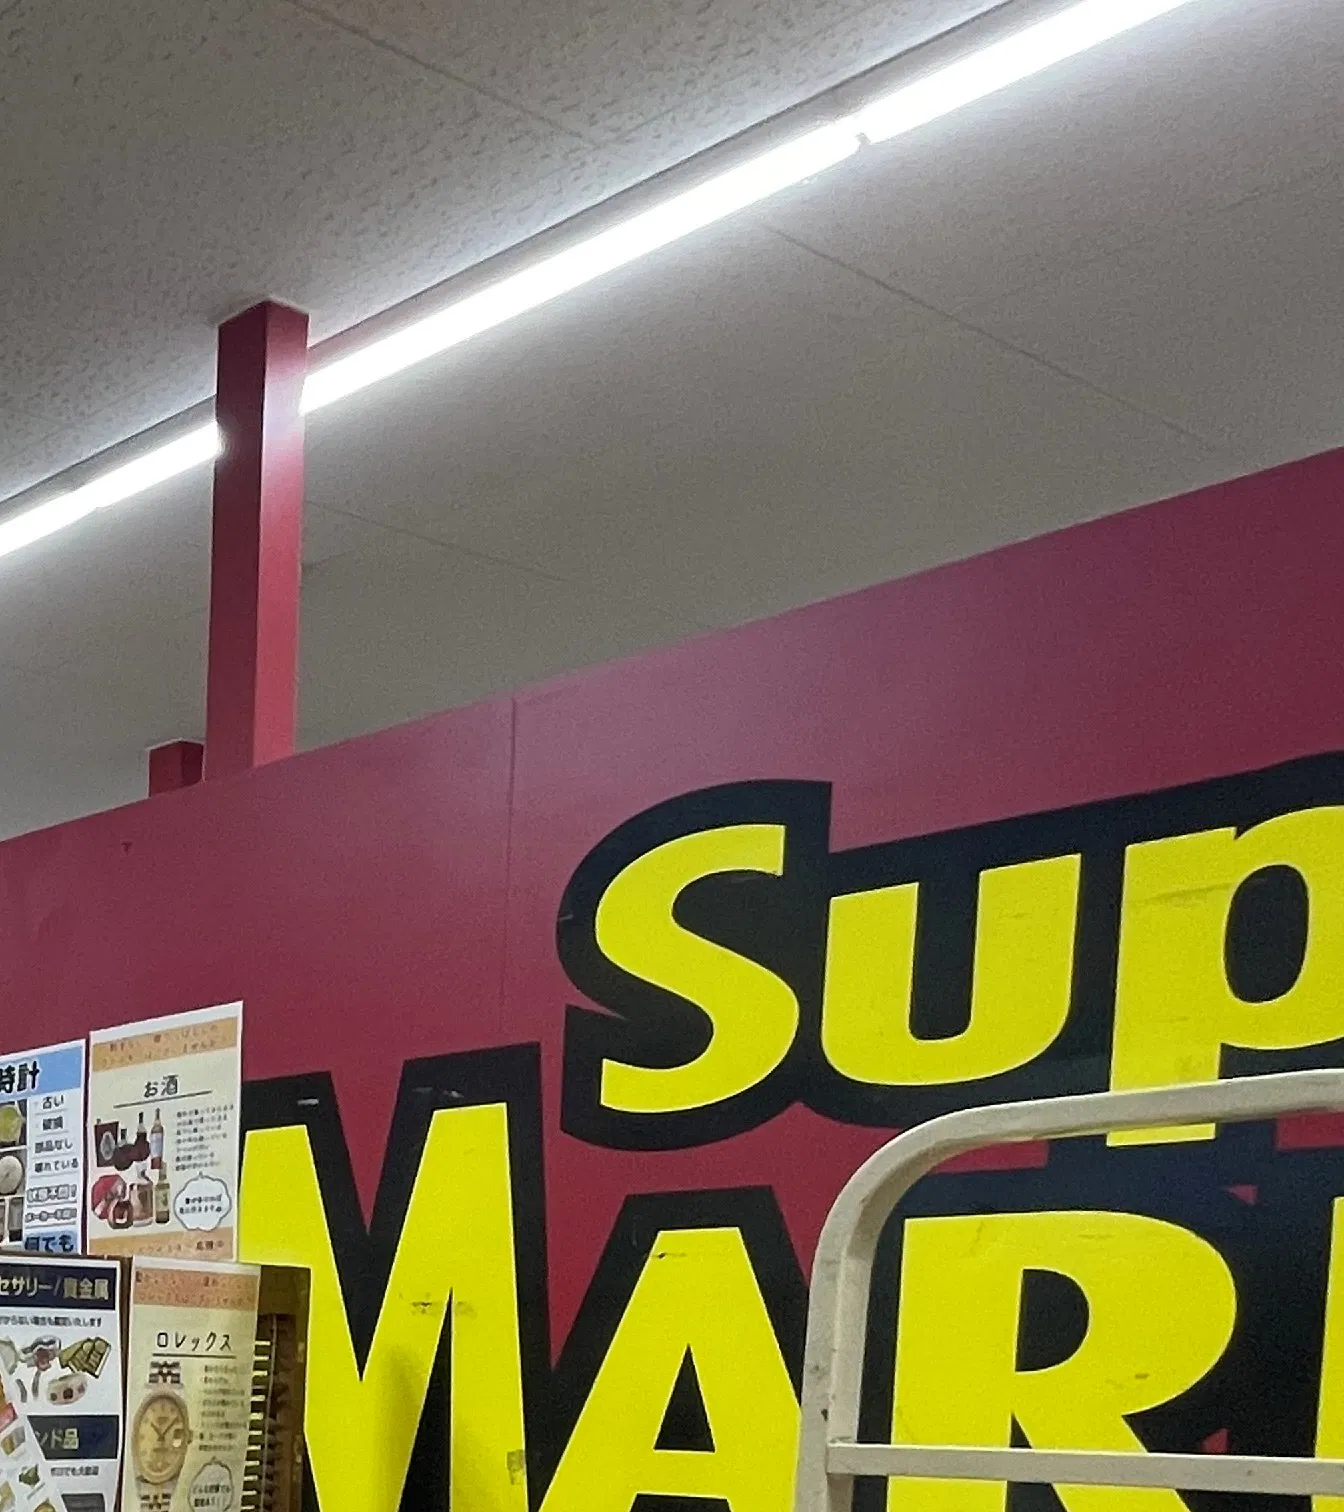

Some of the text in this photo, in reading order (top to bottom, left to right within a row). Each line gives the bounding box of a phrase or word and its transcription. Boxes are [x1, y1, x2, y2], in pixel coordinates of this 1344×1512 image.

[143, 1074, 180, 1098] お酒
[42, 1094, 64, 1111] 古い
[156, 1331, 233, 1352] ロレックス
